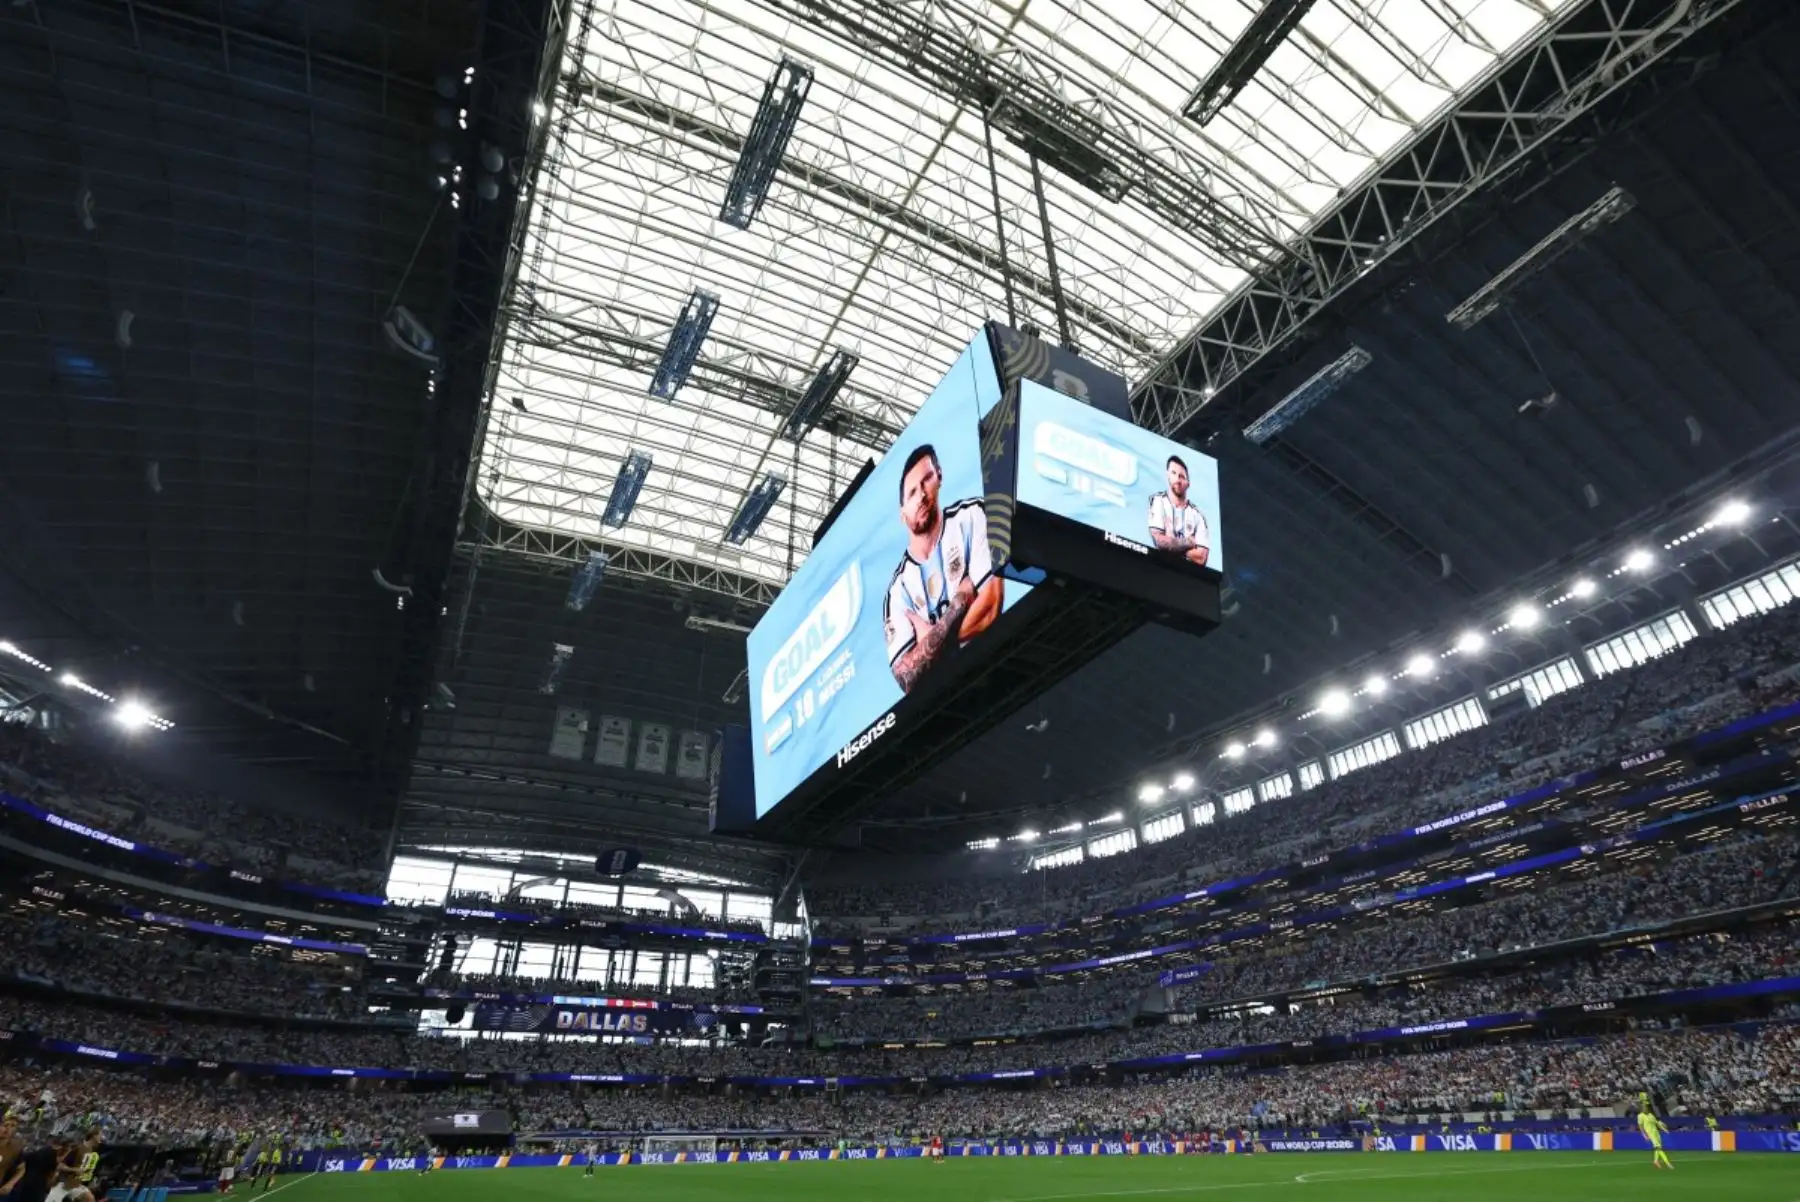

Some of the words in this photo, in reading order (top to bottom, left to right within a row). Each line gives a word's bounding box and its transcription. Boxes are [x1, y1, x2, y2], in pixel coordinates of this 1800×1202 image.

[1104, 530, 1149, 555] Hisense
[774, 611, 836, 693] GOAL
[837, 712, 896, 768] Hisense
[1620, 750, 1666, 770] DALLAS
[1666, 770, 1720, 791] DALLAS
[1739, 794, 1789, 812] DALLAS
[62, 820, 92, 837] WORLD
[1414, 825, 1432, 835] FIFA
[1432, 816, 1460, 830] WORLD
[1460, 811, 1477, 821] CUP
[556, 1010, 647, 1032] DALLAS
[1067, 1144, 1084, 1154] VISA
[1104, 1143, 1123, 1154] VISA
[1271, 1142, 1286, 1150] FIFA
[1286, 1141, 1311, 1150] WORLD
[1312, 1140, 1326, 1149] CUP
[1326, 1139, 1351, 1149] 2026
[1374, 1137, 1396, 1151] ISA
[1437, 1135, 1478, 1151] VISA
[1525, 1133, 1572, 1149] VISA
[1761, 1132, 1800, 1150] VIS
[641, 1153, 664, 1164] VISA
[695, 1152, 717, 1163] VISA
[747, 1151, 769, 1162] VISA
[798, 1149, 819, 1160] VISA
[847, 1148, 867, 1159] VISA
[325, 1159, 344, 1172] ISA
[386, 1158, 416, 1170] VISA
